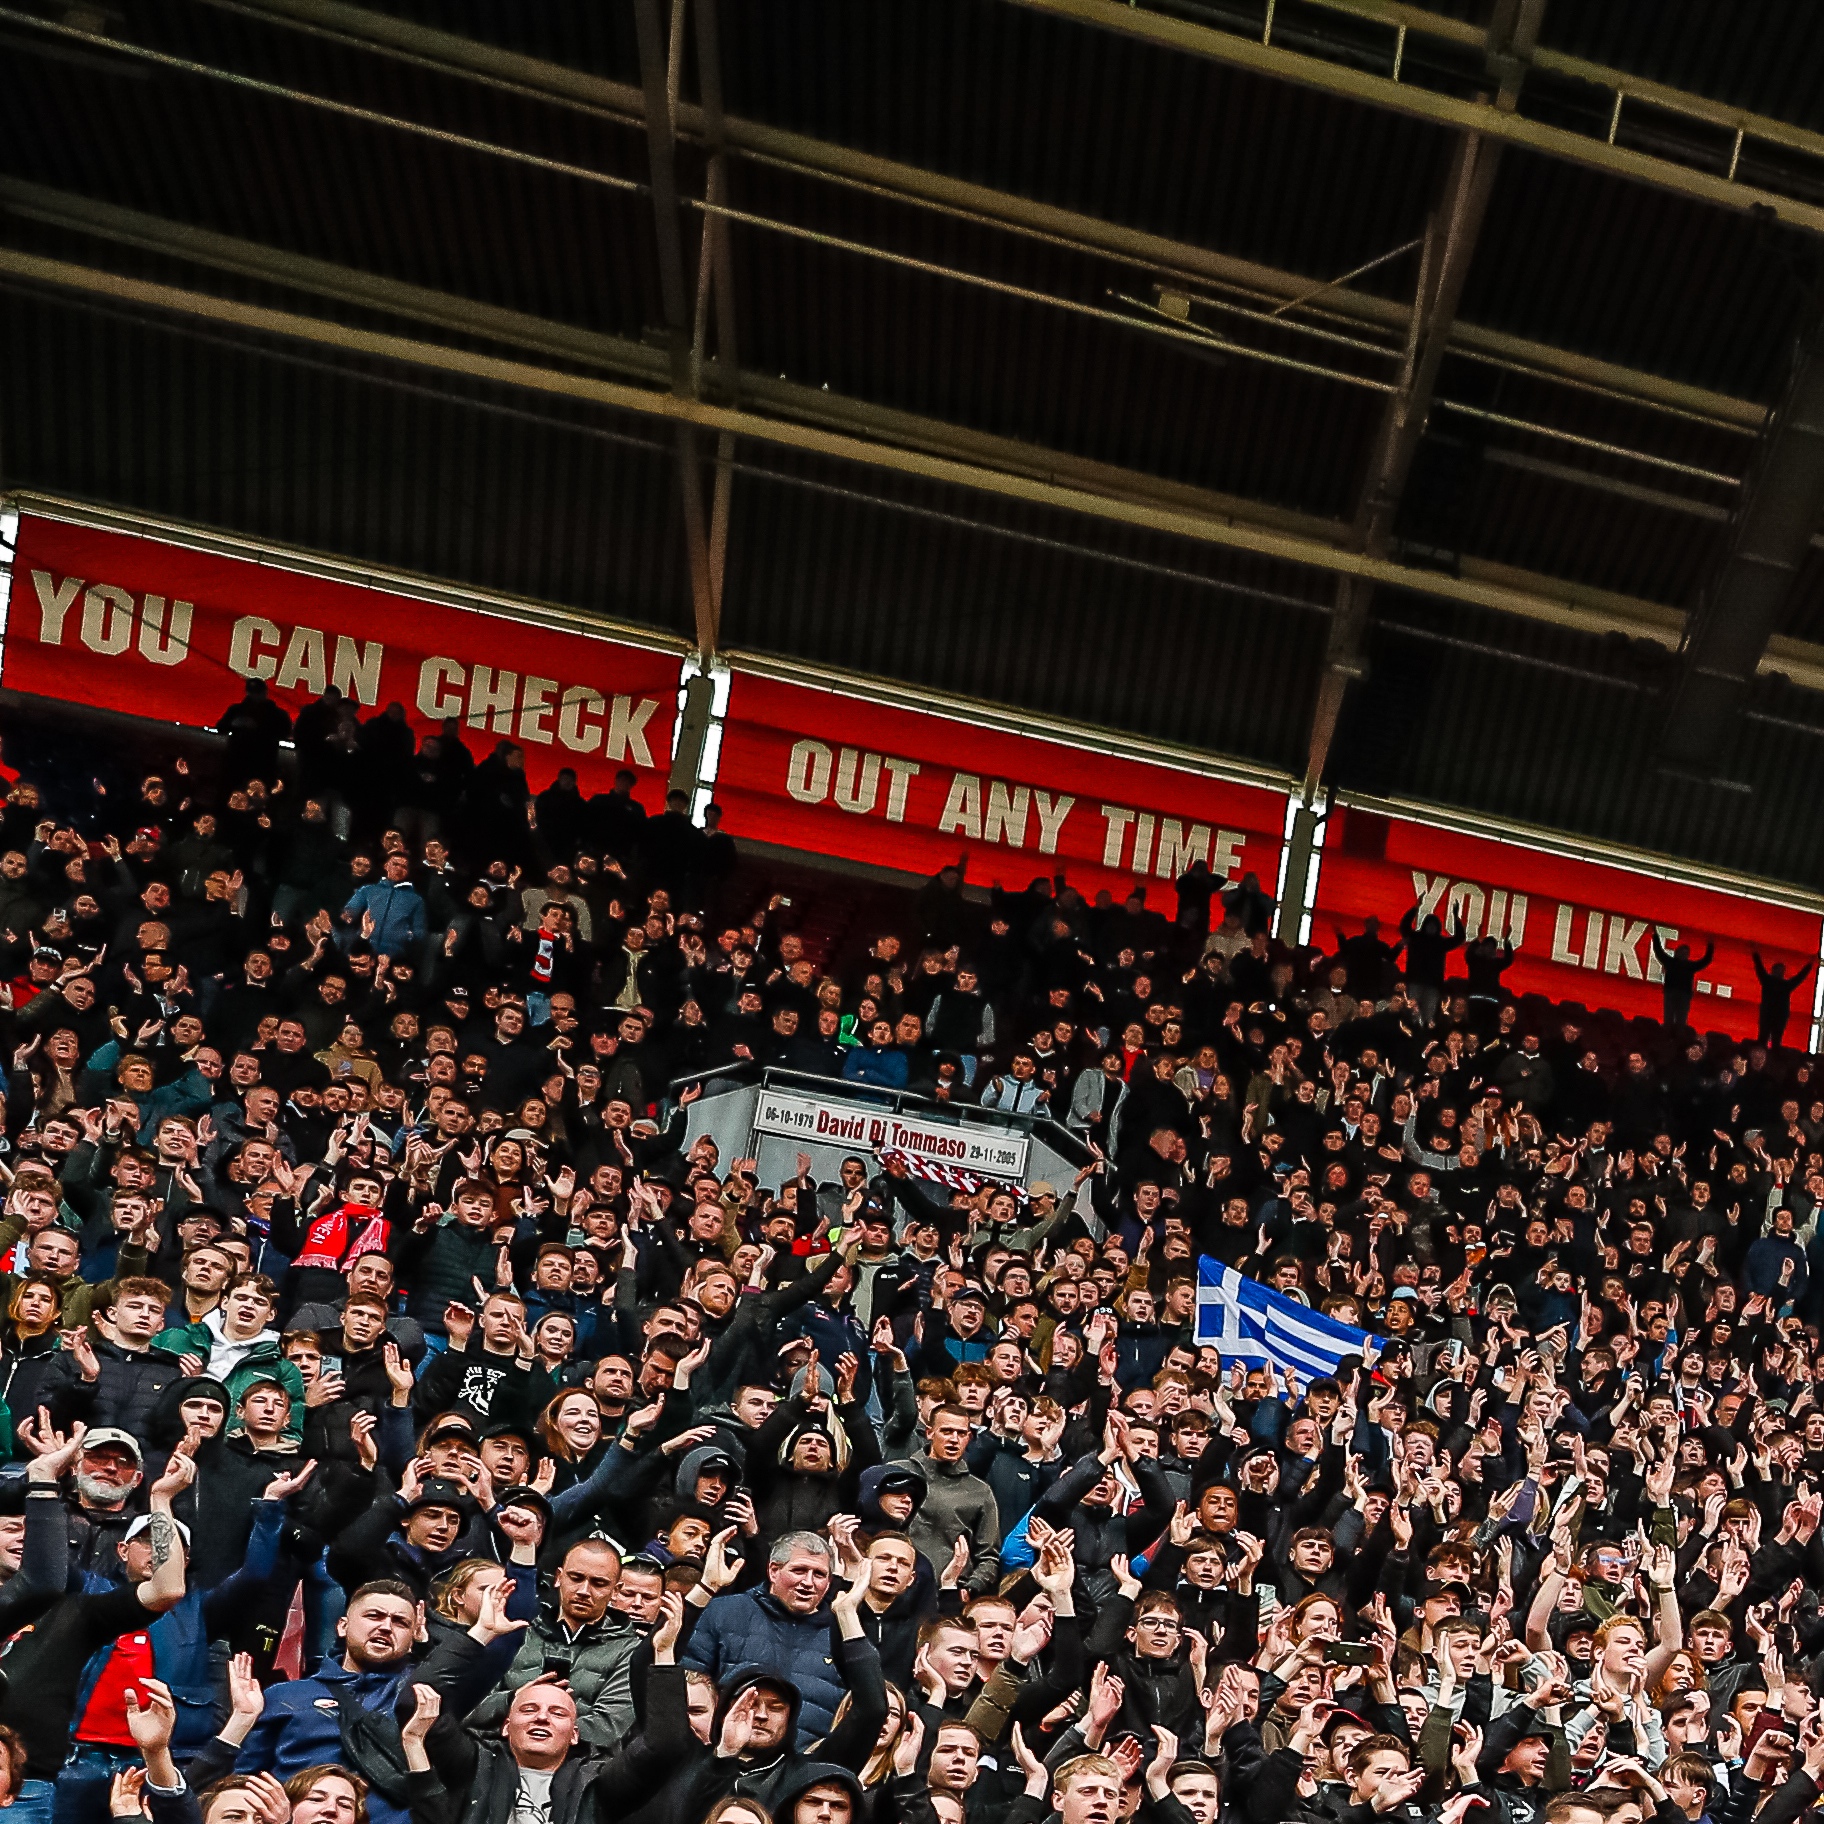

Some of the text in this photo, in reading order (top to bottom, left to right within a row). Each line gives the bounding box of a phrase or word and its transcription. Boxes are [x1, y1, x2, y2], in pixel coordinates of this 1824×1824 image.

[31, 570, 661, 768] YOU CAN CHECK
[786, 739, 1246, 891] OUT ANY TIME
[1412, 870, 1527, 951] YOU
[817, 1110, 865, 1140] David
[892, 1122, 966, 1159] Tommaso
